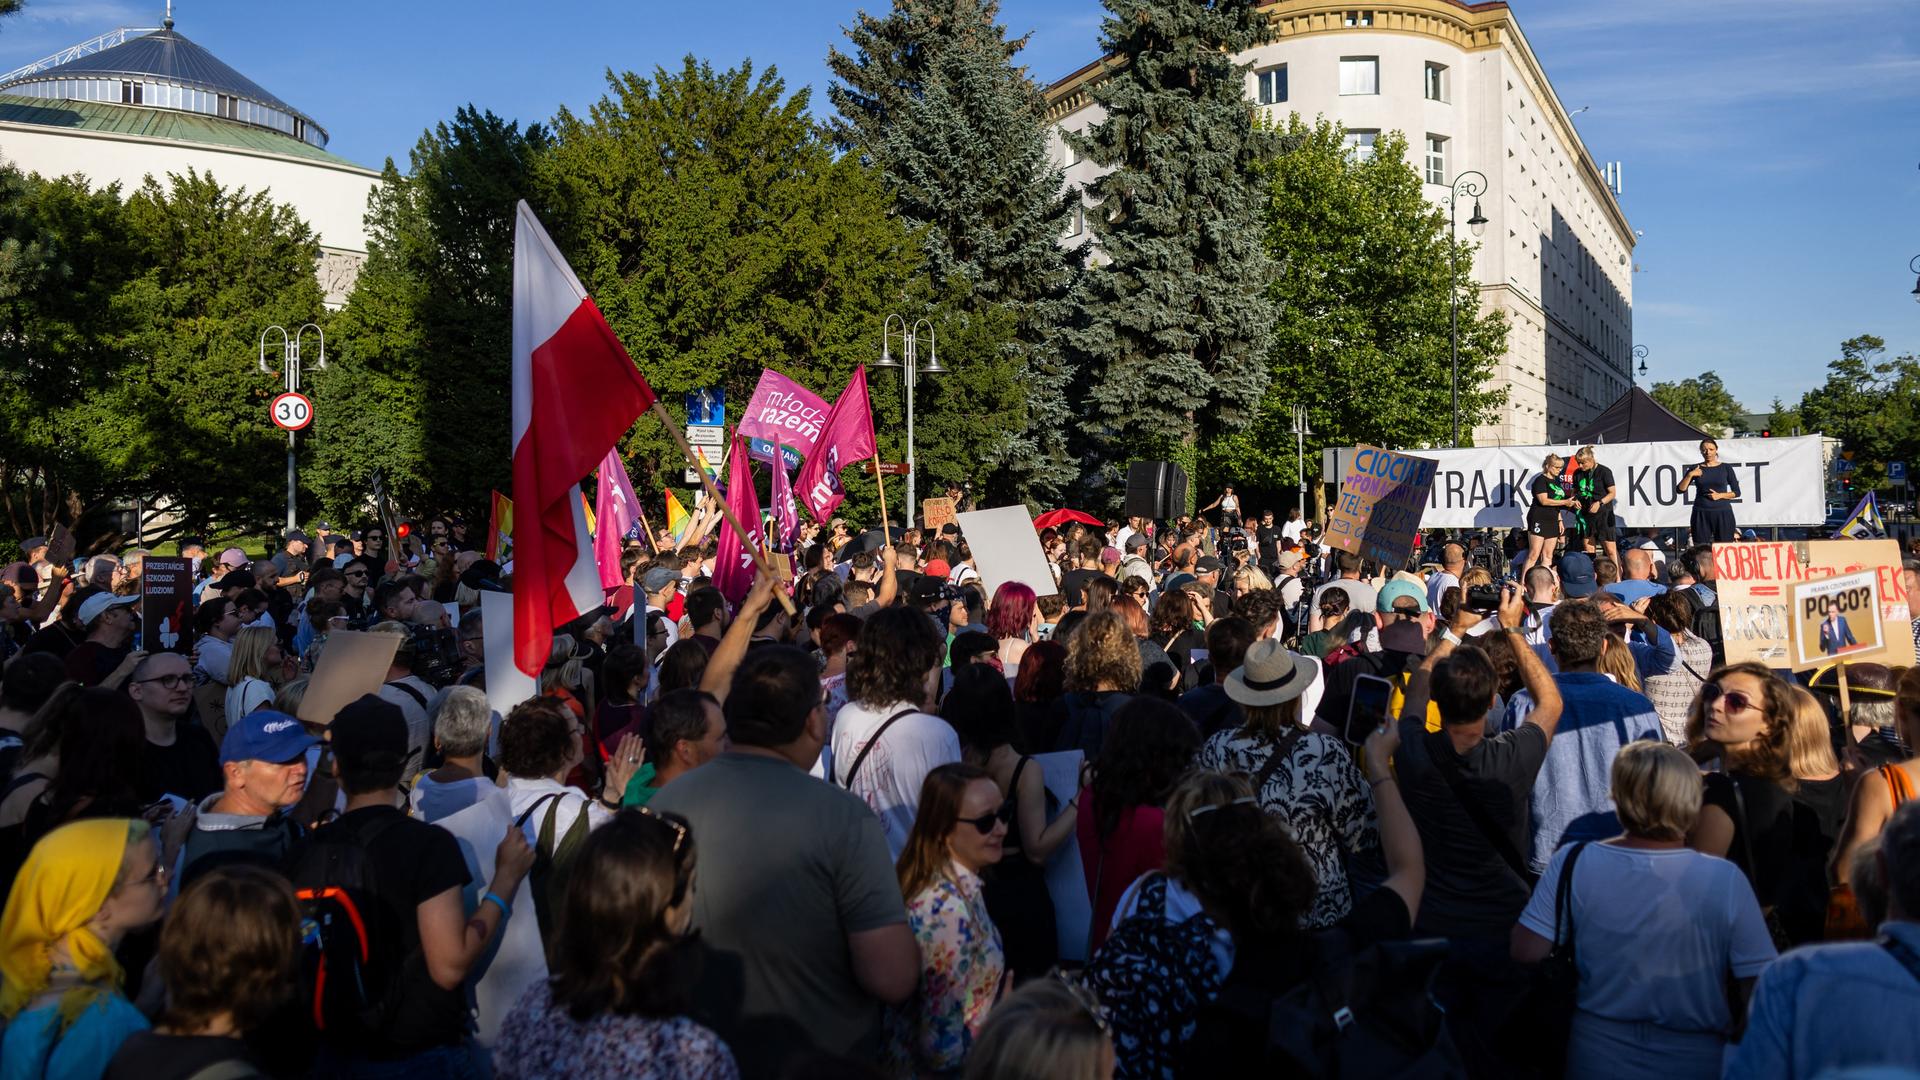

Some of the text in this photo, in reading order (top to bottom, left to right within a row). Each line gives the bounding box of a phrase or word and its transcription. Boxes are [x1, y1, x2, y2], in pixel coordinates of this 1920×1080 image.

[278, 403, 307, 420] 30
[758, 406, 821, 443] razem
[1431, 468, 1530, 509] TRAJK
[145, 573, 175, 582] SZKODZIĆ
[1712, 543, 1801, 581] KOBIETA
[1805, 587, 1870, 620] PO CO?
